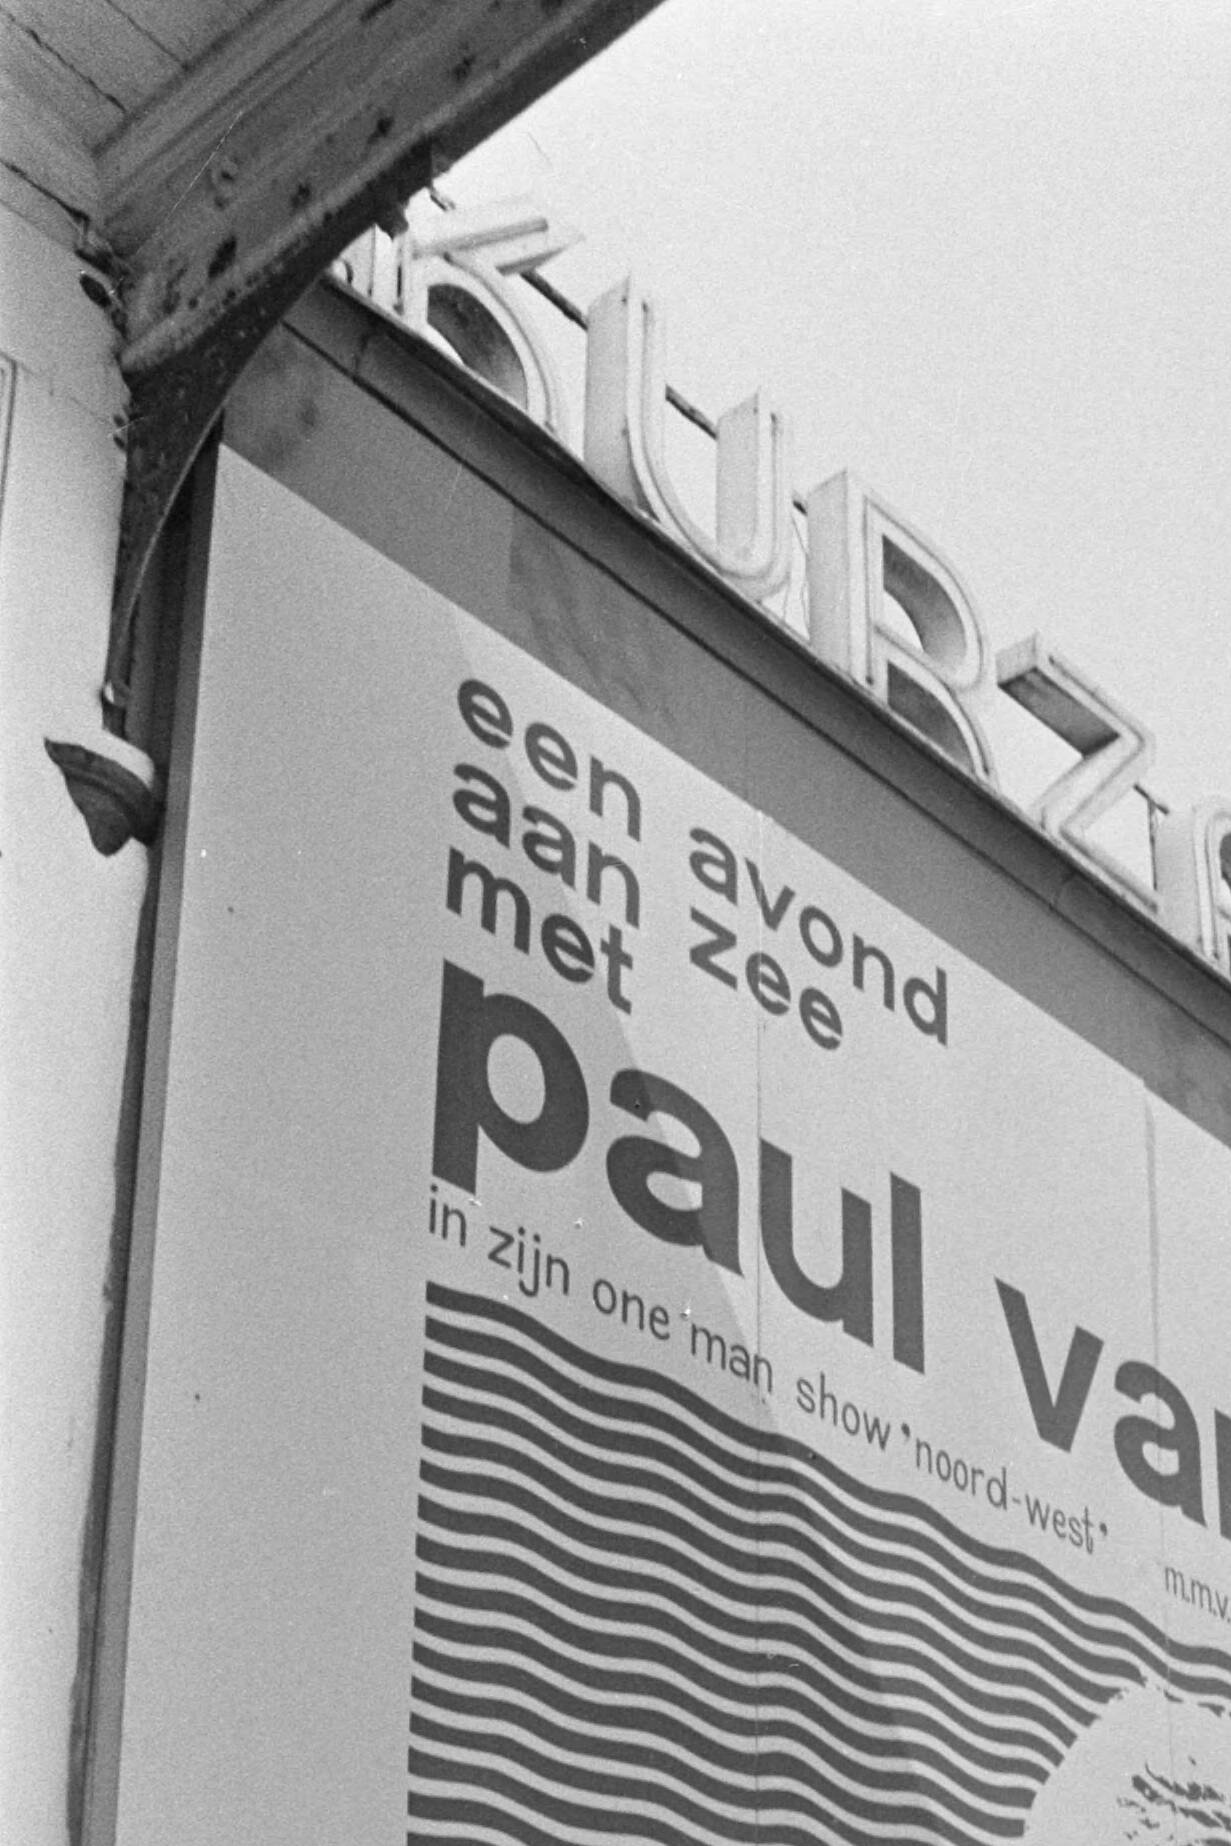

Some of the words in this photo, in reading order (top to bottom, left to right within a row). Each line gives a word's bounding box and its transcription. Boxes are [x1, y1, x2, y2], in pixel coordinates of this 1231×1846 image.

[445, 846, 634, 1016] met
[451, 762, 642, 931] aan
[688, 905, 845, 1052] zee
[456, 678, 641, 843] een
[688, 827, 949, 1049] avond
[431, 958, 925, 1375] paul
[428, 1183, 468, 1248] in
[487, 1225, 571, 1297] zijn
[591, 1277, 672, 1342] one
[689, 1321, 774, 1396] man
[794, 1371, 892, 1452] show
[1163, 1565, 1231, 1624] m.m.v.
